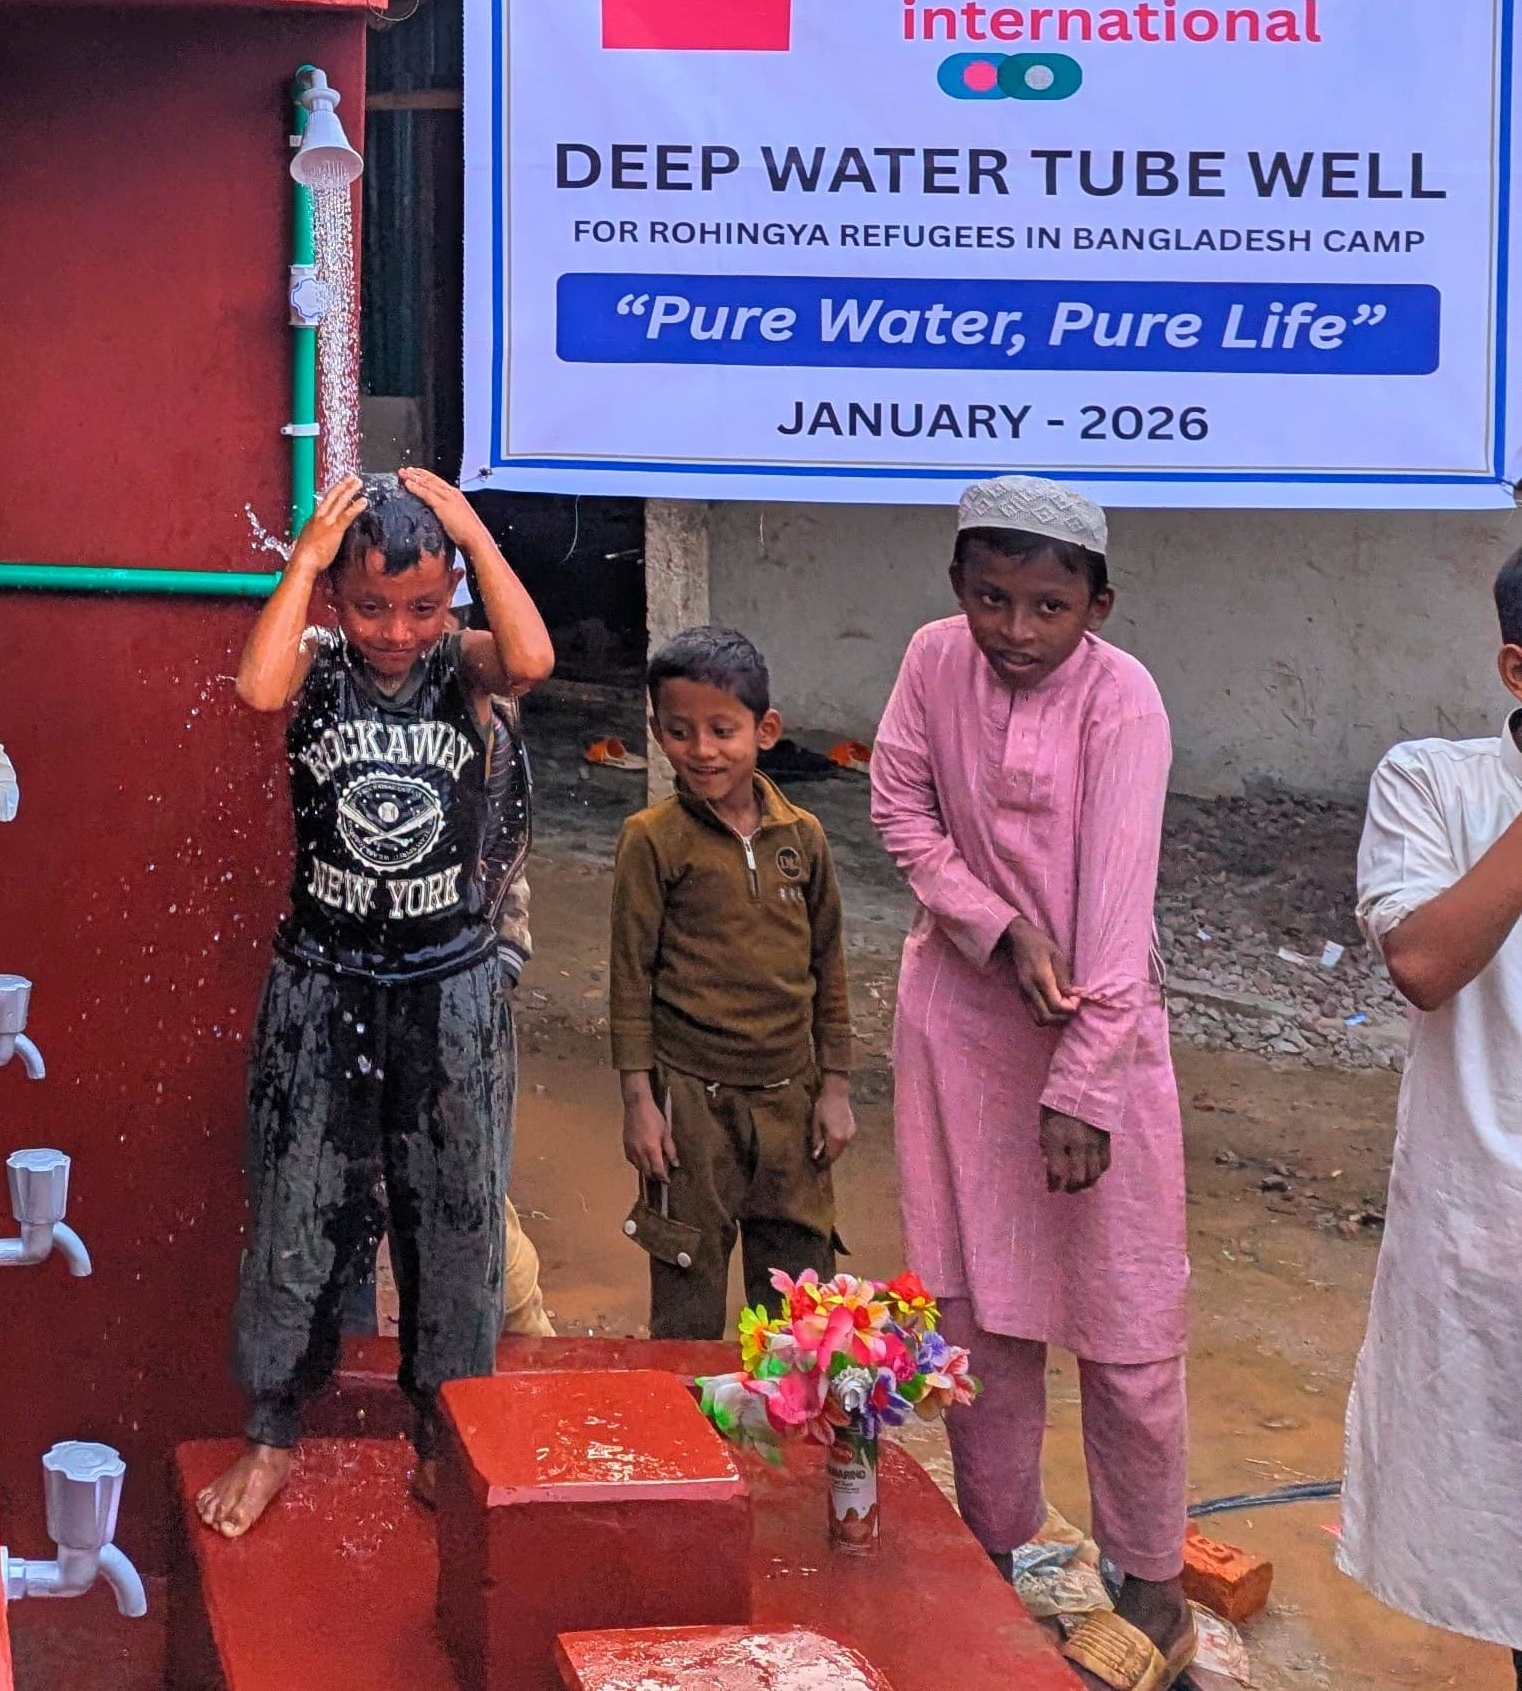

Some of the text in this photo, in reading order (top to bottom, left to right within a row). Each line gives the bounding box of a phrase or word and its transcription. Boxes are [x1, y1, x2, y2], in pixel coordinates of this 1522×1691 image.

[556, 143, 1447, 199] DEEP WATER TUBE WELL
[574, 220, 1425, 253] FOR ROHINGYA REFUGEES IN BANGLADESH CAMP
[616, 293, 1387, 357] “Pure Water, Pure Life”
[776, 401, 1209, 441] JANUARY - 2026
[308, 856, 463, 919] NEW YORK
